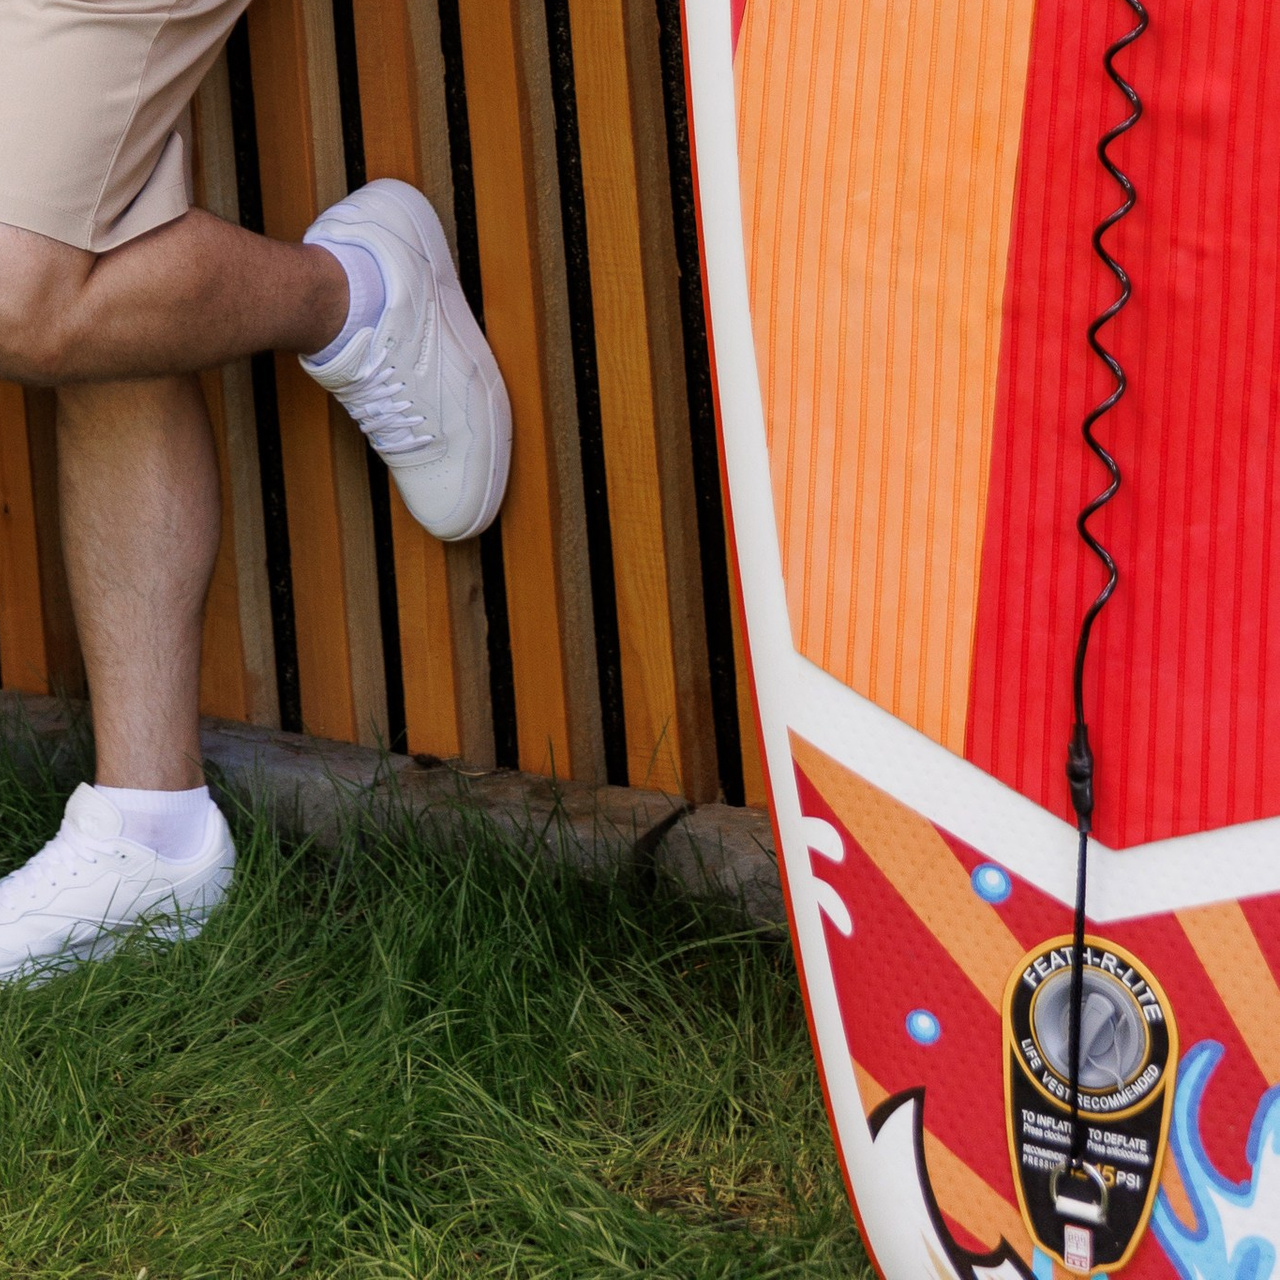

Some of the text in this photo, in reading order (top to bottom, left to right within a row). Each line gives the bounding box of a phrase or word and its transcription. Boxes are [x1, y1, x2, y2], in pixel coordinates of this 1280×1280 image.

[1021, 1038, 1159, 1110] LIFE VEST RECOMMENDED
[1022, 1109, 1036, 1123] TO
[1088, 1127, 1147, 1151] TO DEFLATE
[1116, 1170, 1141, 1190] PSI
